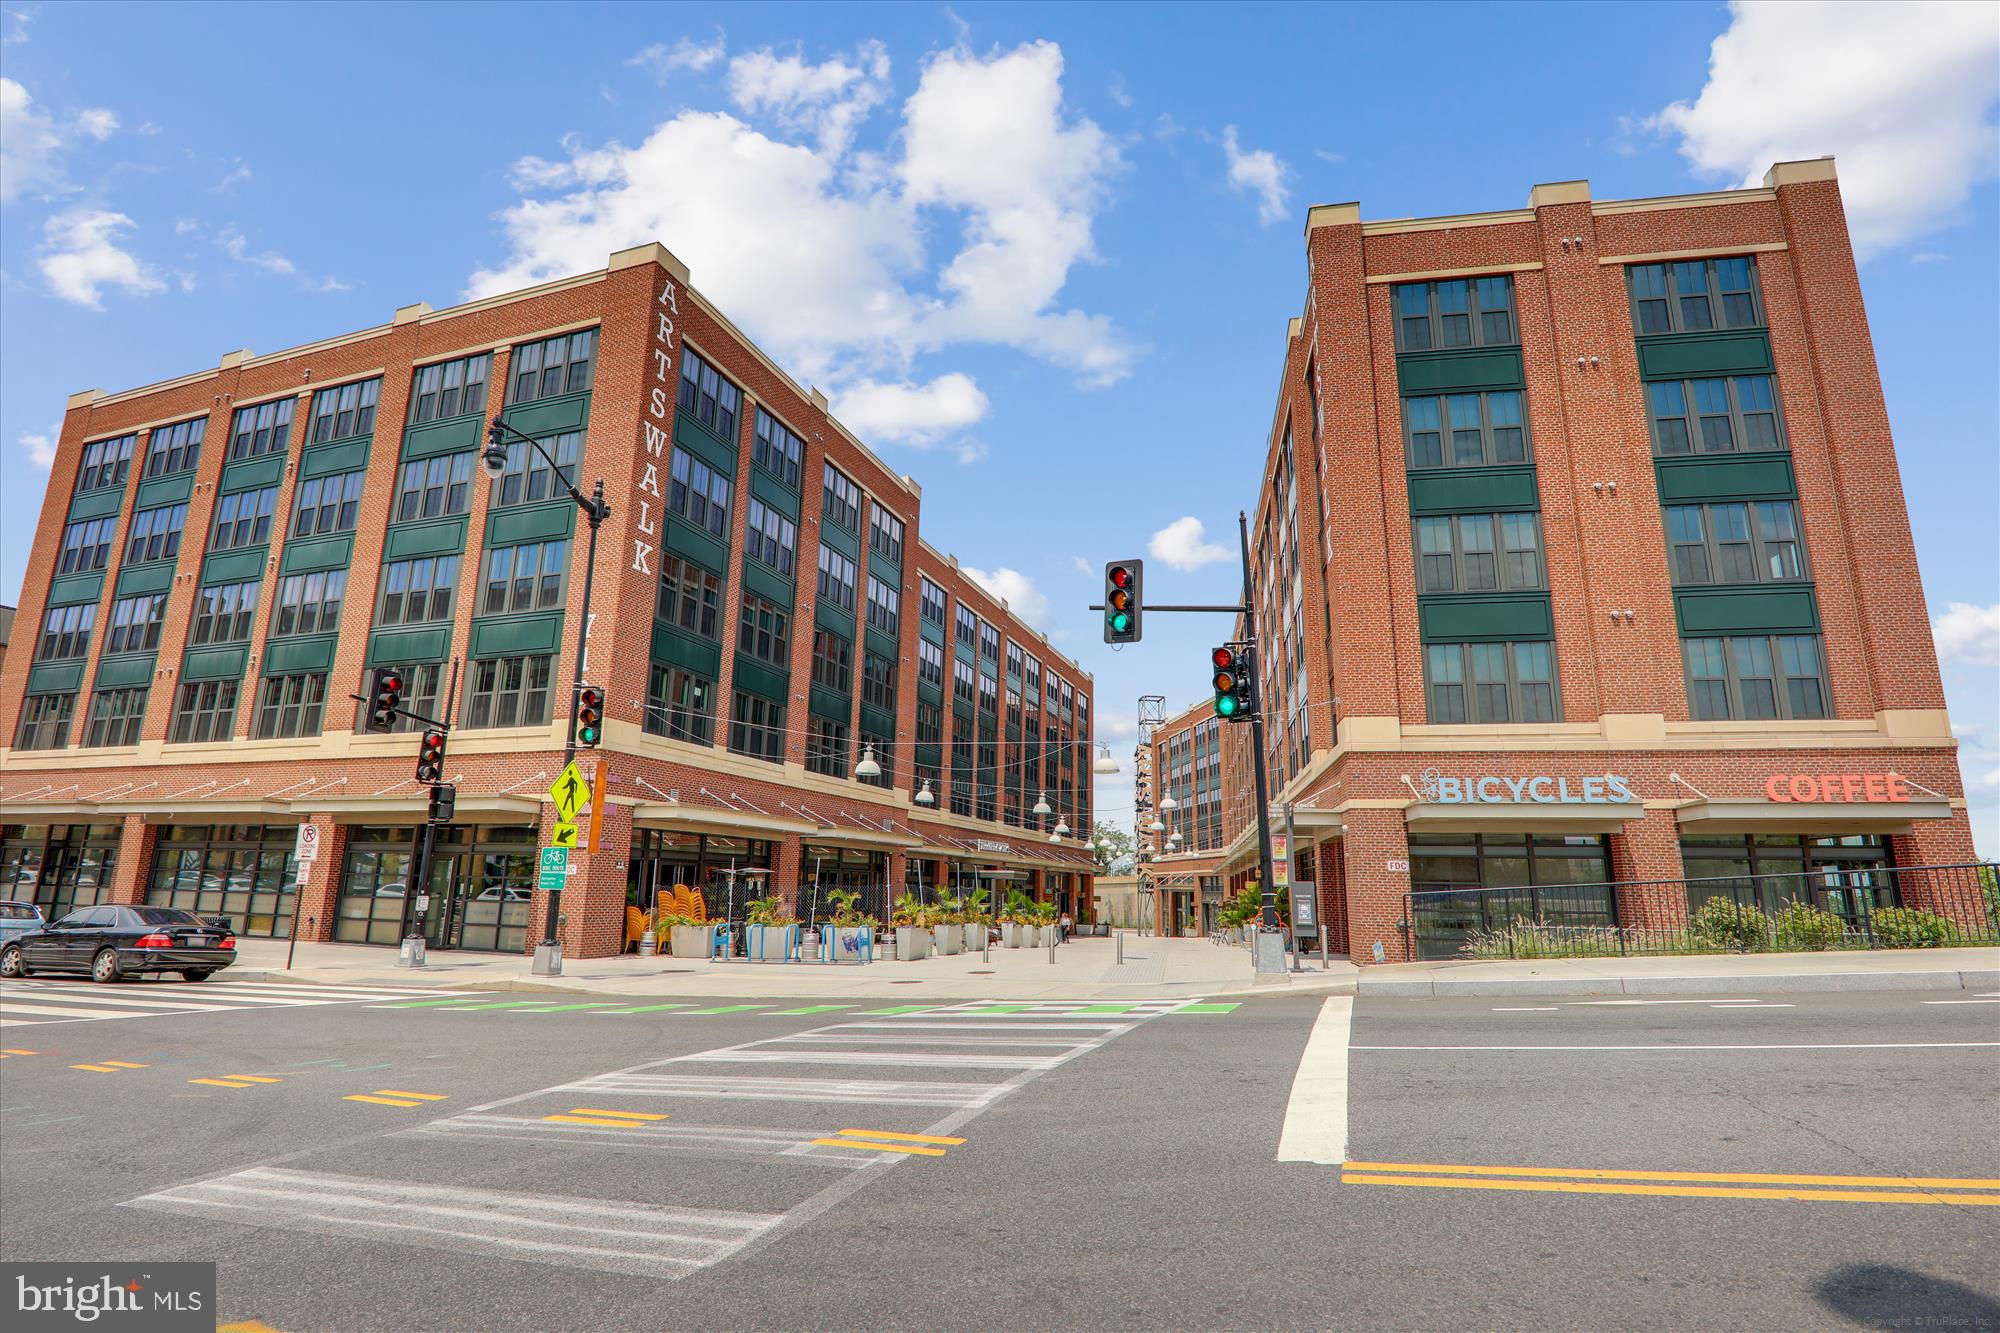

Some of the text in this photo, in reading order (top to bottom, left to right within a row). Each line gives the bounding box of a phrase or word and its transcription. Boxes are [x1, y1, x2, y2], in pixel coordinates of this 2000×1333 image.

[631, 279, 678, 576] ARTSWALK
[1438, 776, 1631, 804] BICYCLES
[1765, 773, 1910, 803] COFFEE
[1389, 861, 1407, 871] FDC
